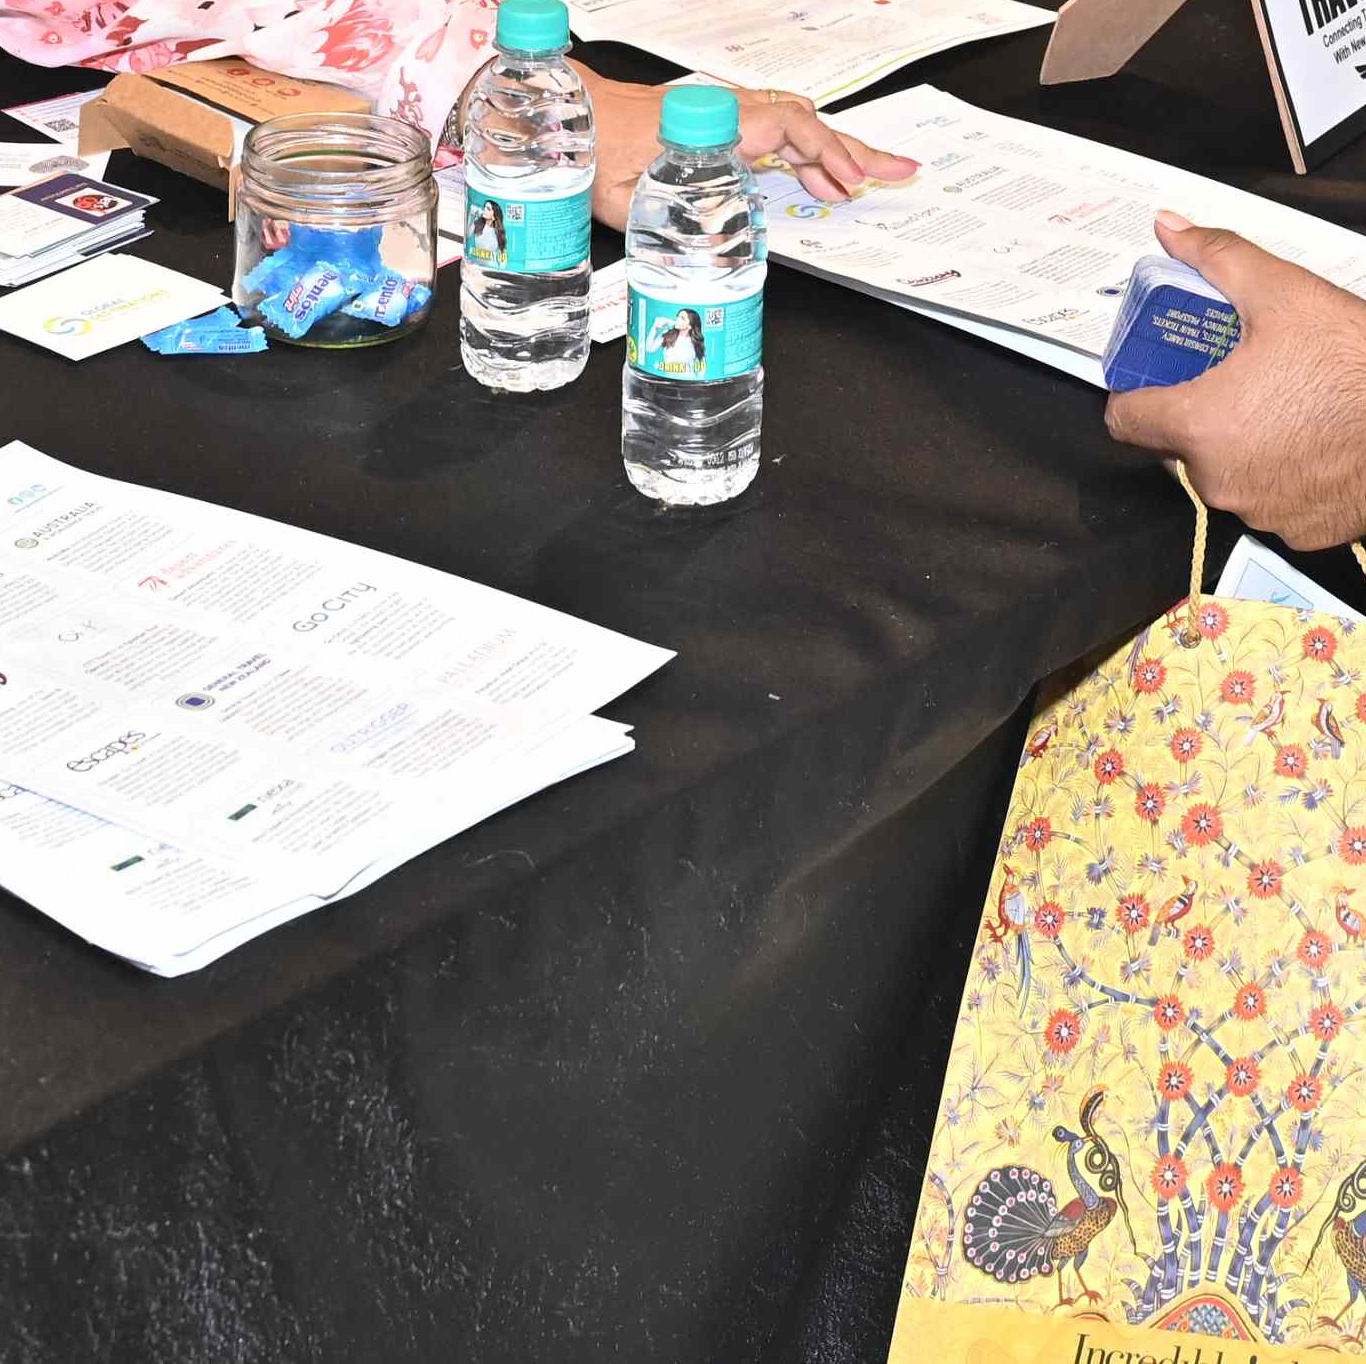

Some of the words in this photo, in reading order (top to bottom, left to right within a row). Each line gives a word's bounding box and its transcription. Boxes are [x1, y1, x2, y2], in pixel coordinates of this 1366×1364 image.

[1323, 15, 1363, 48] Connecting
[1333, 44, 1352, 65] With
[1350, 35, 1366, 54] New
[33, 500, 97, 539] AUSTRALIA
[66, 730, 147, 772] escapes
